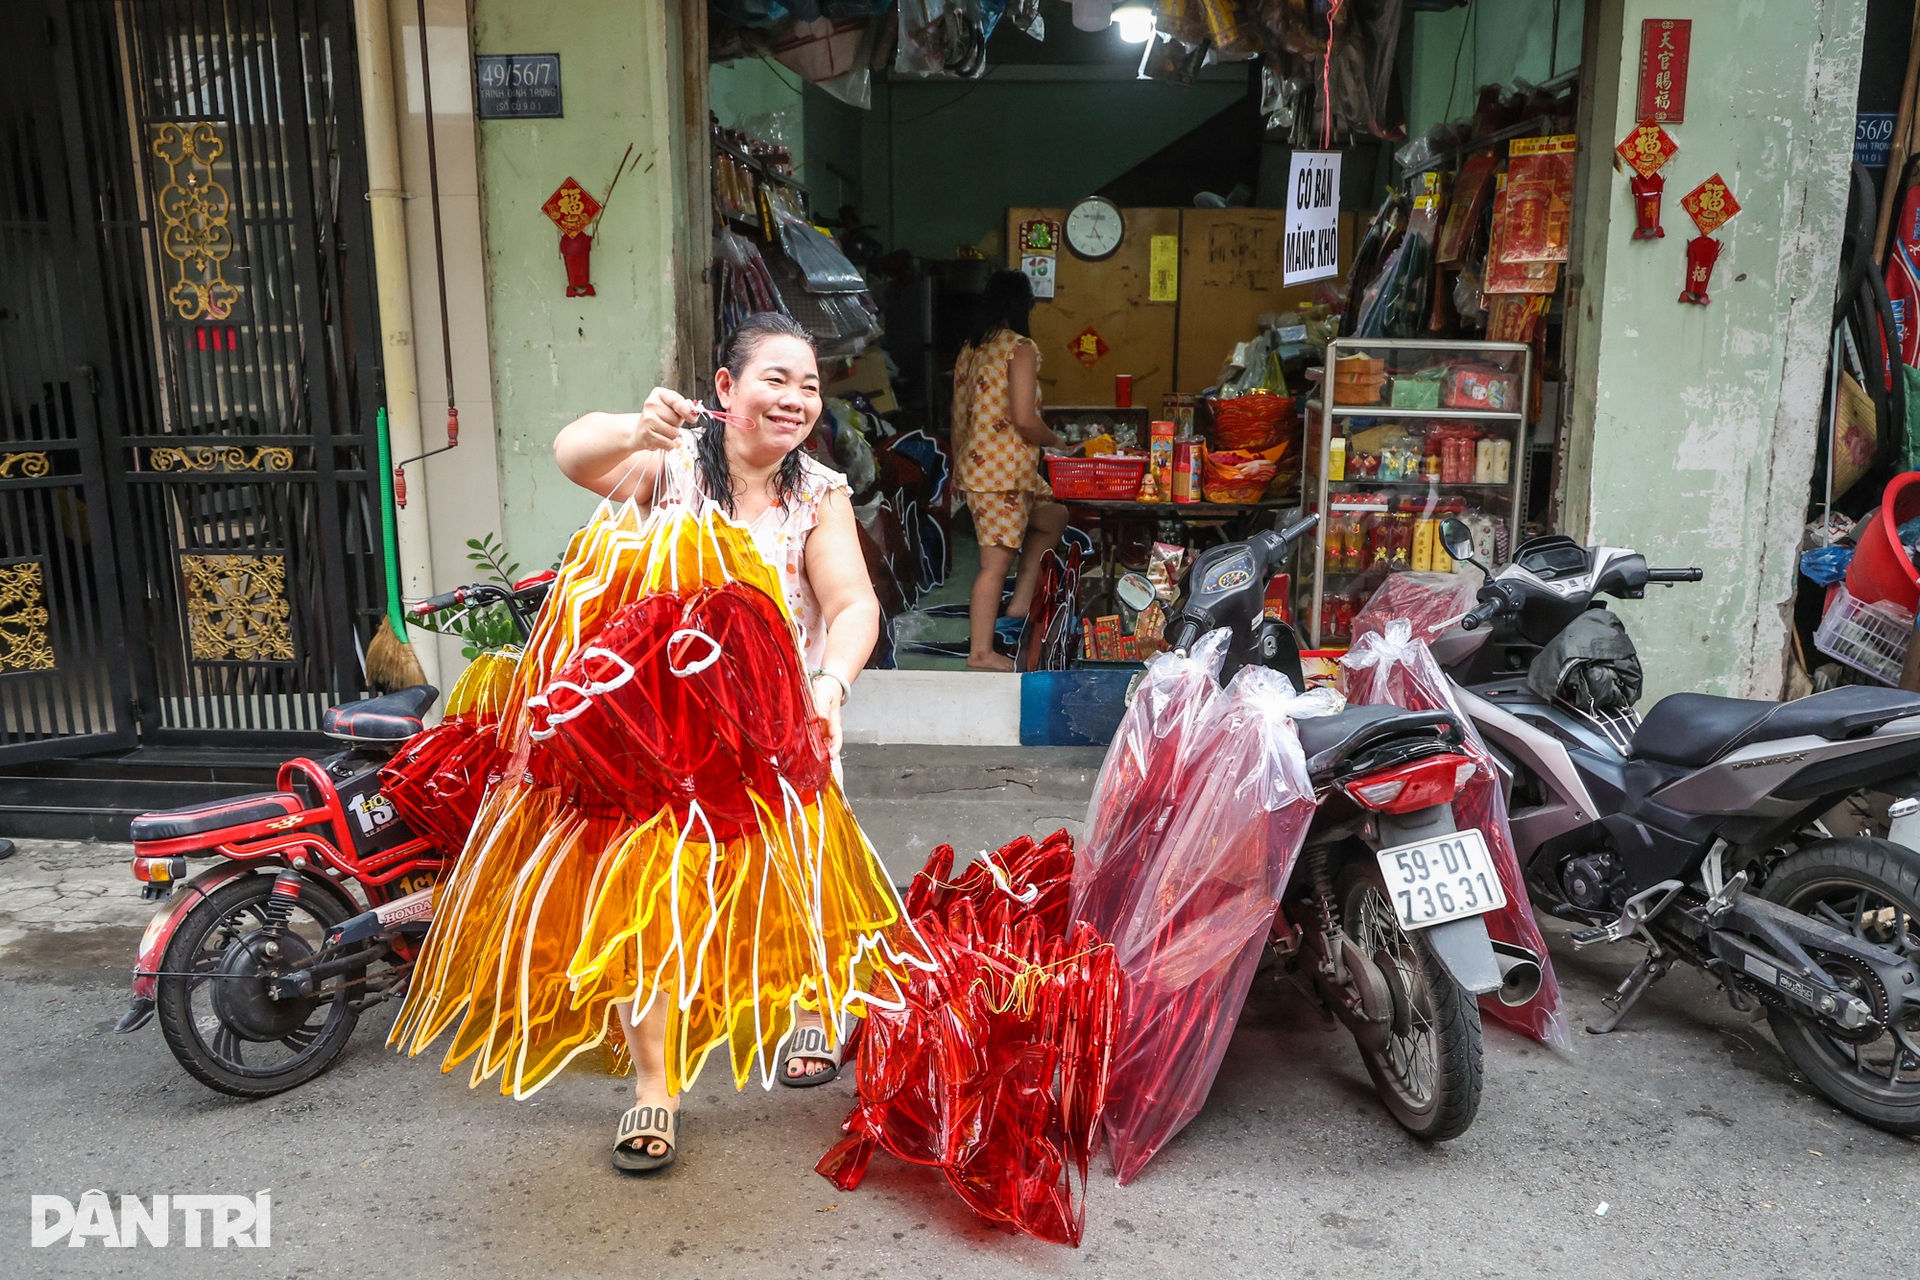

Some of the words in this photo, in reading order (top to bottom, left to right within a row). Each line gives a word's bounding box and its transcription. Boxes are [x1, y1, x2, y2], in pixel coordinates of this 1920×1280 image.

[482, 63, 551, 87] 49/56/7
[1655, 31, 1675, 109] 天官賜福
[1634, 126, 1662, 154] 福
[1856, 119, 1893, 140] 56/9
[1871, 141, 1892, 152] TRỌN
[1297, 158, 1313, 210] CÓ
[1314, 158, 1333, 209] BÁN
[1699, 183, 1726, 210] 福
[557, 187, 585, 215] 福
[1285, 223, 1315, 273] MĂNG
[1317, 217, 1337, 268] KHÔ
[1029, 257, 1049, 277] 16
[1692, 266, 1707, 282] 福
[1395, 839, 1472, 884] 59-D1
[385, 900, 433, 924] HONDA
[1397, 872, 1494, 926] 736.31
